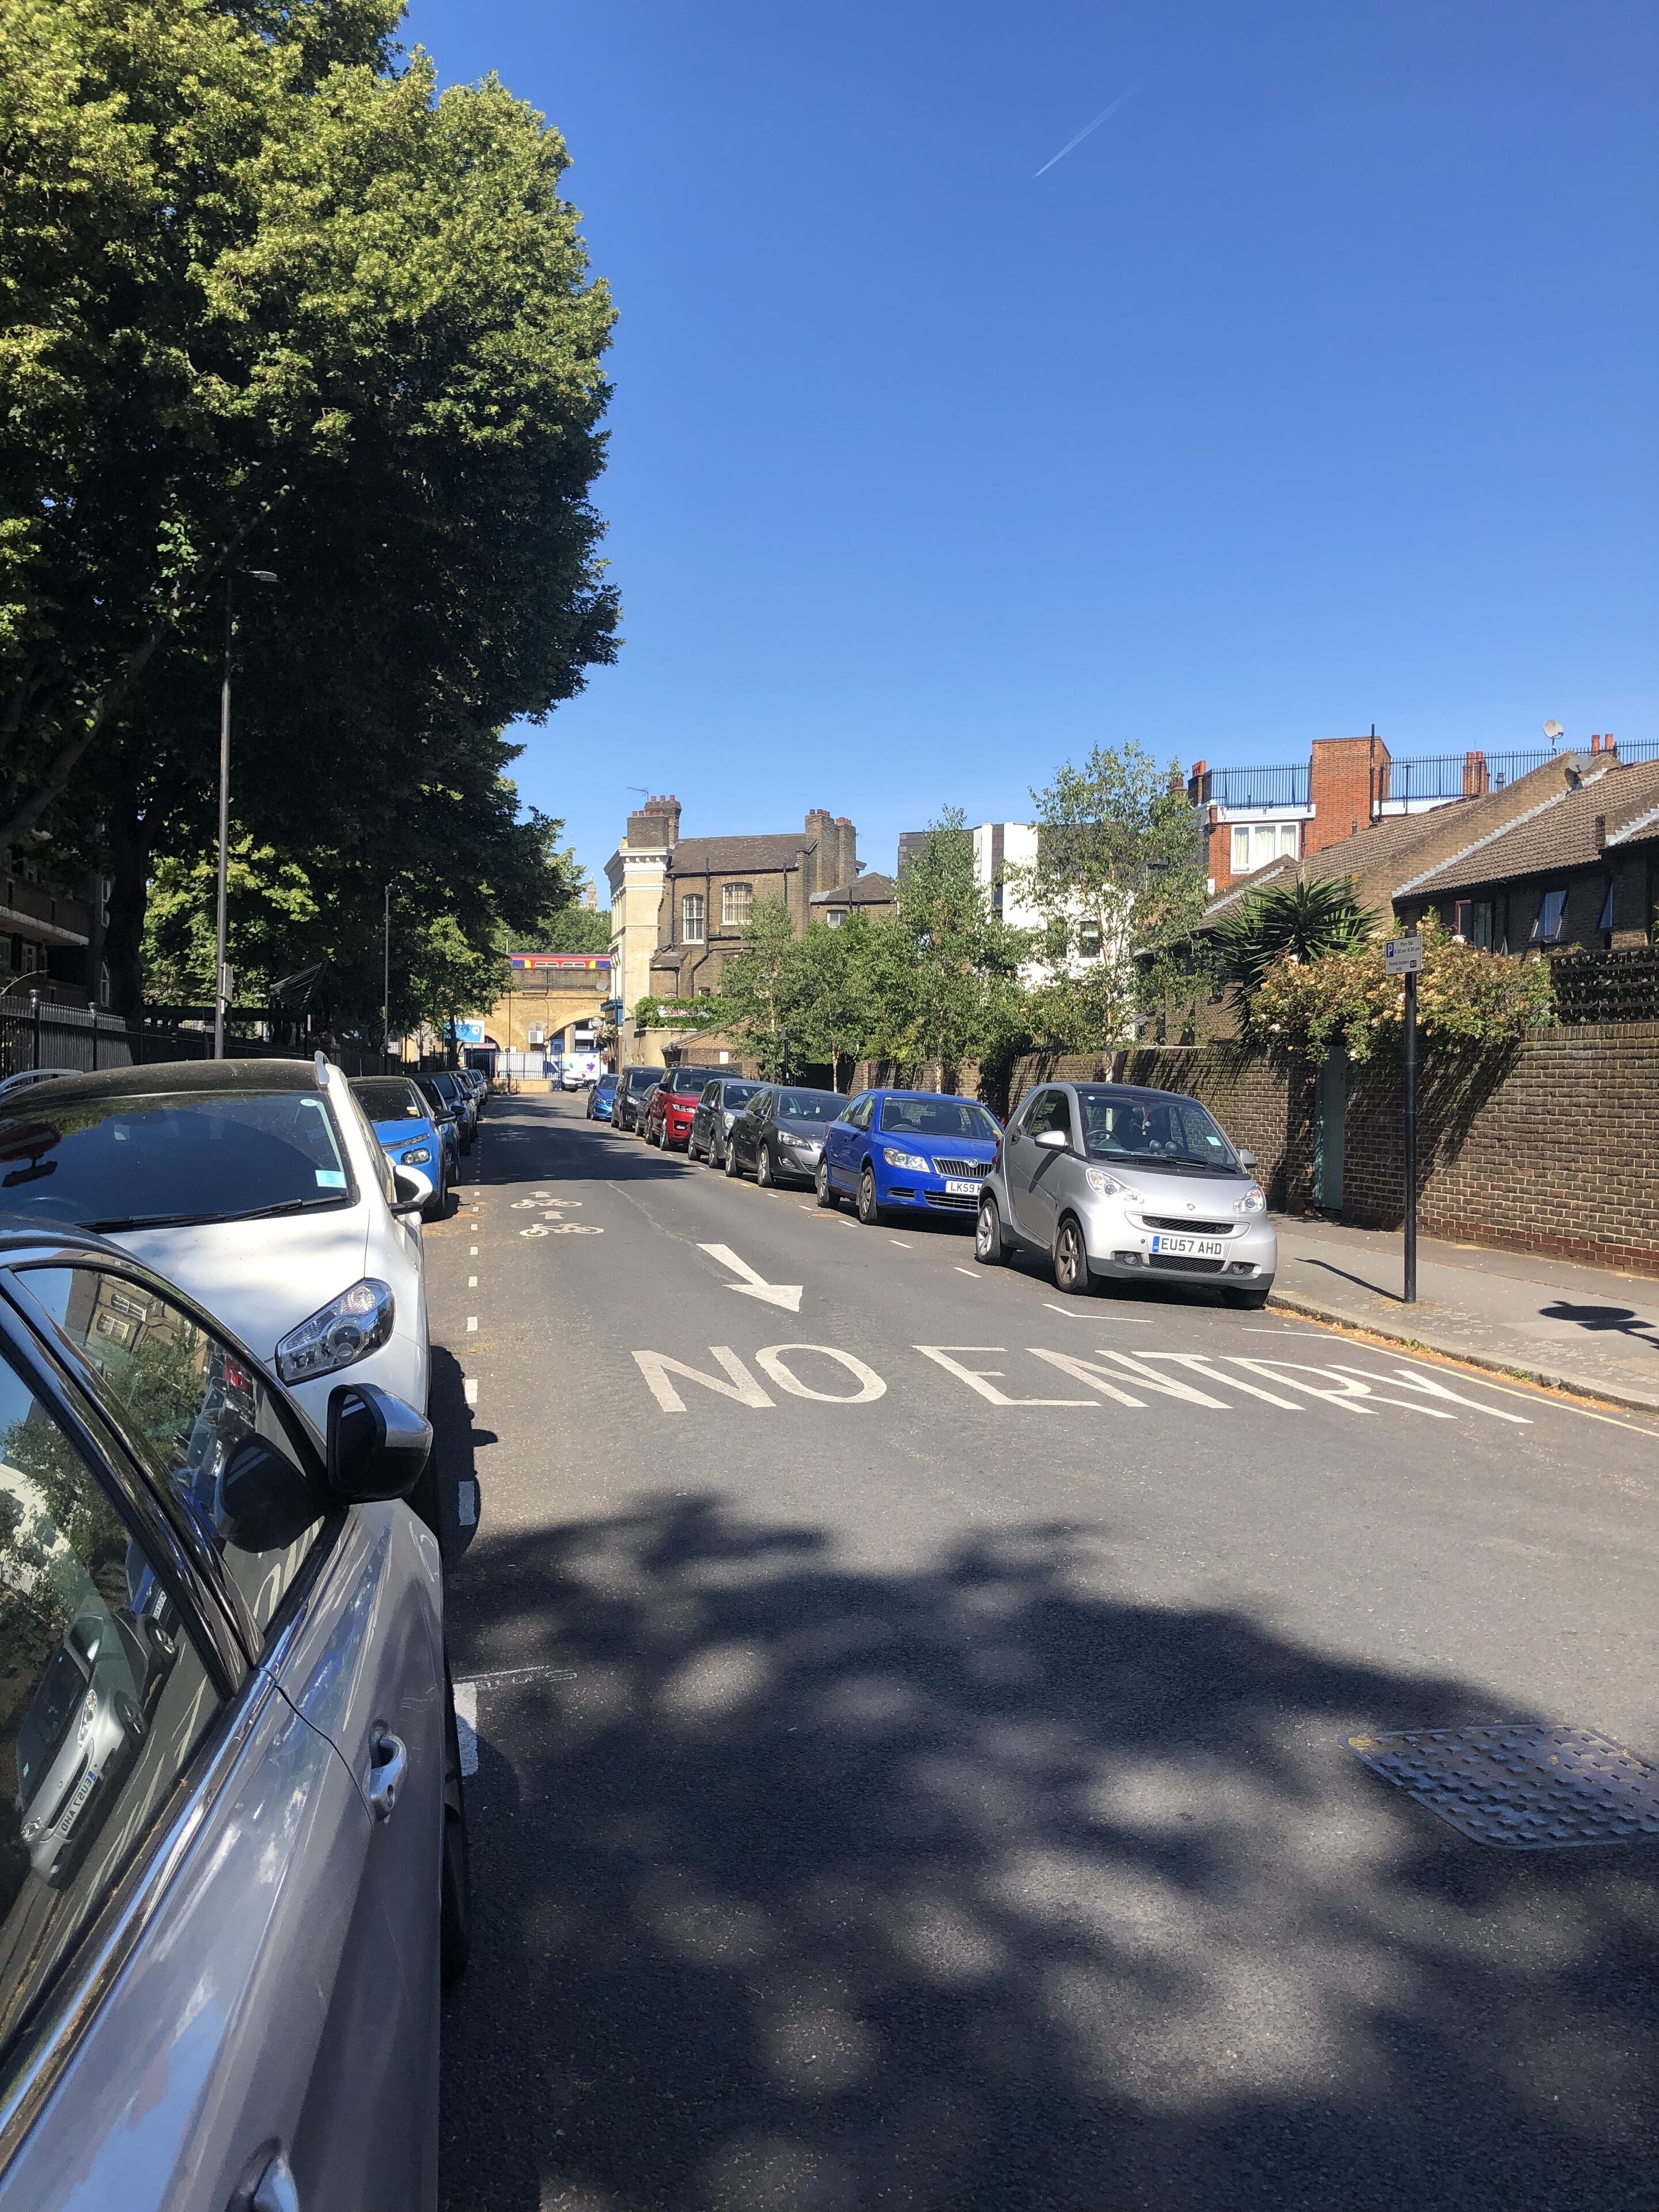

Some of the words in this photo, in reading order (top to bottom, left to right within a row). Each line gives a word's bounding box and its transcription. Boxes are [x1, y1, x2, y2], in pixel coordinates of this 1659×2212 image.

[1388, 944, 1393, 957] P
[950, 1183, 975, 1192] LK59
[1161, 1238, 1195, 1252] EU57
[1198, 1241, 1222, 1255] AHD
[631, 1344, 887, 1412] NO
[911, 1345, 1534, 1423] ENTRY
